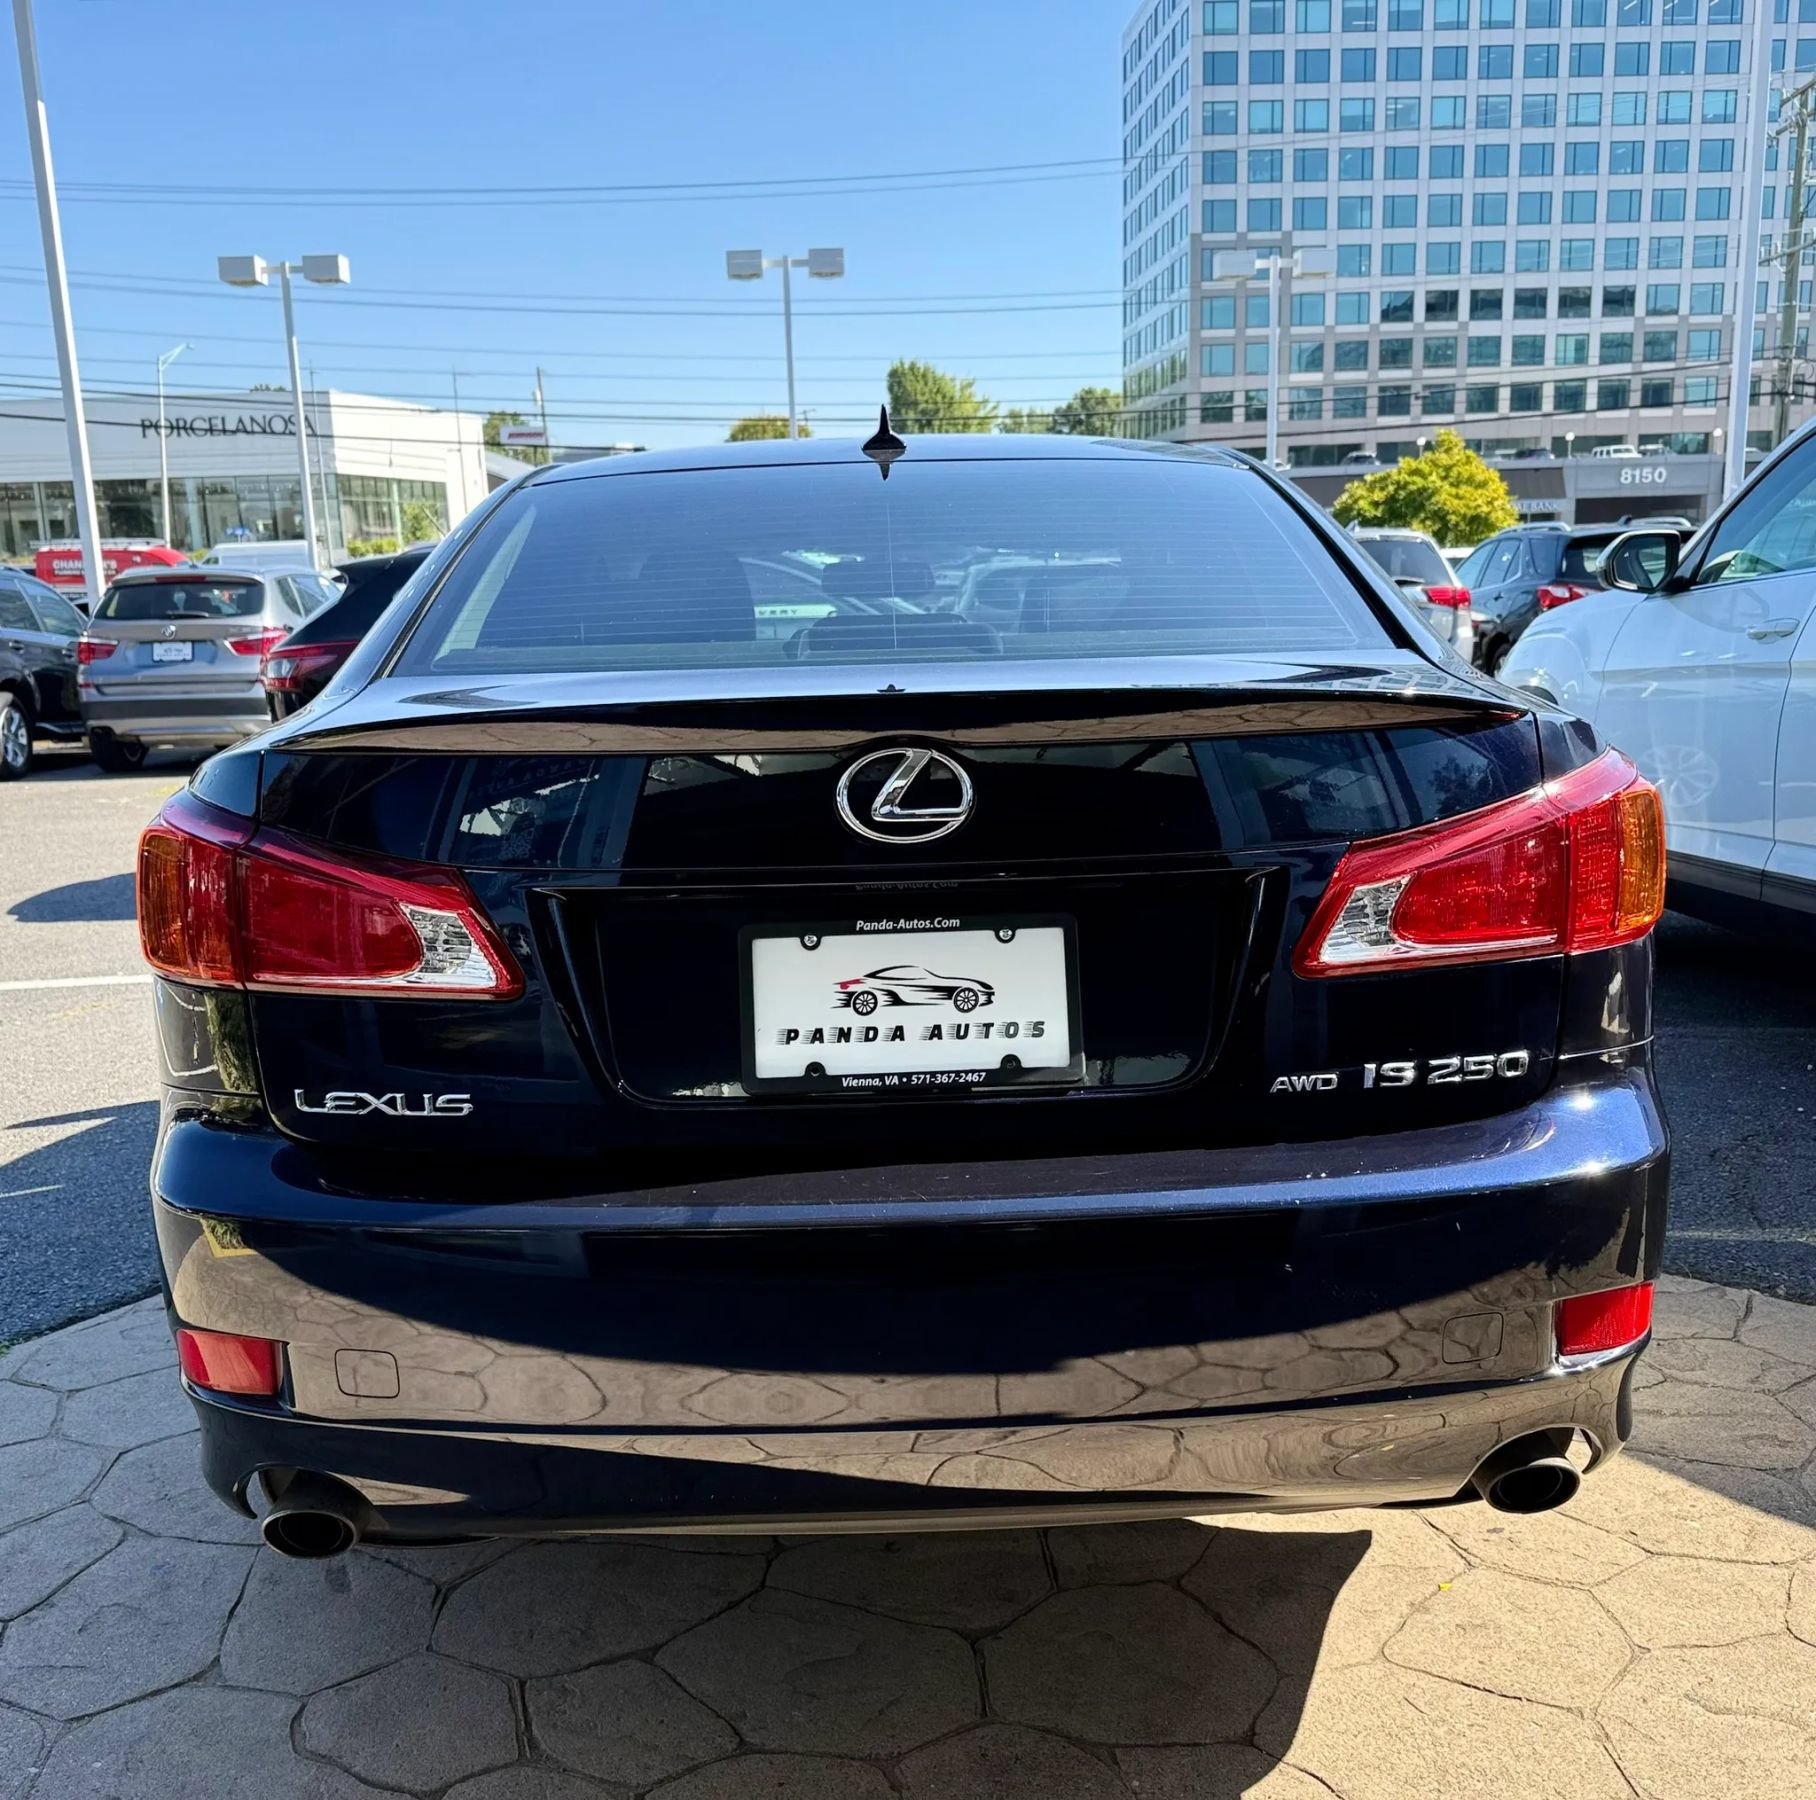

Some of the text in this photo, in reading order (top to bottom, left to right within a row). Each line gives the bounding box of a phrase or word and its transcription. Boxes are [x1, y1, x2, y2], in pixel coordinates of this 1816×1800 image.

[1620, 466, 1667, 484] 8150
[856, 917, 960, 931] Panda-Autos.Com
[776, 1021, 1045, 1045] PANDA AUTOS
[841, 1072, 986, 1087] Vienna, VA 571-367-2467
[1270, 1050, 1529, 1093] AWD IS 250
[294, 1089, 473, 1116] LEXUS
